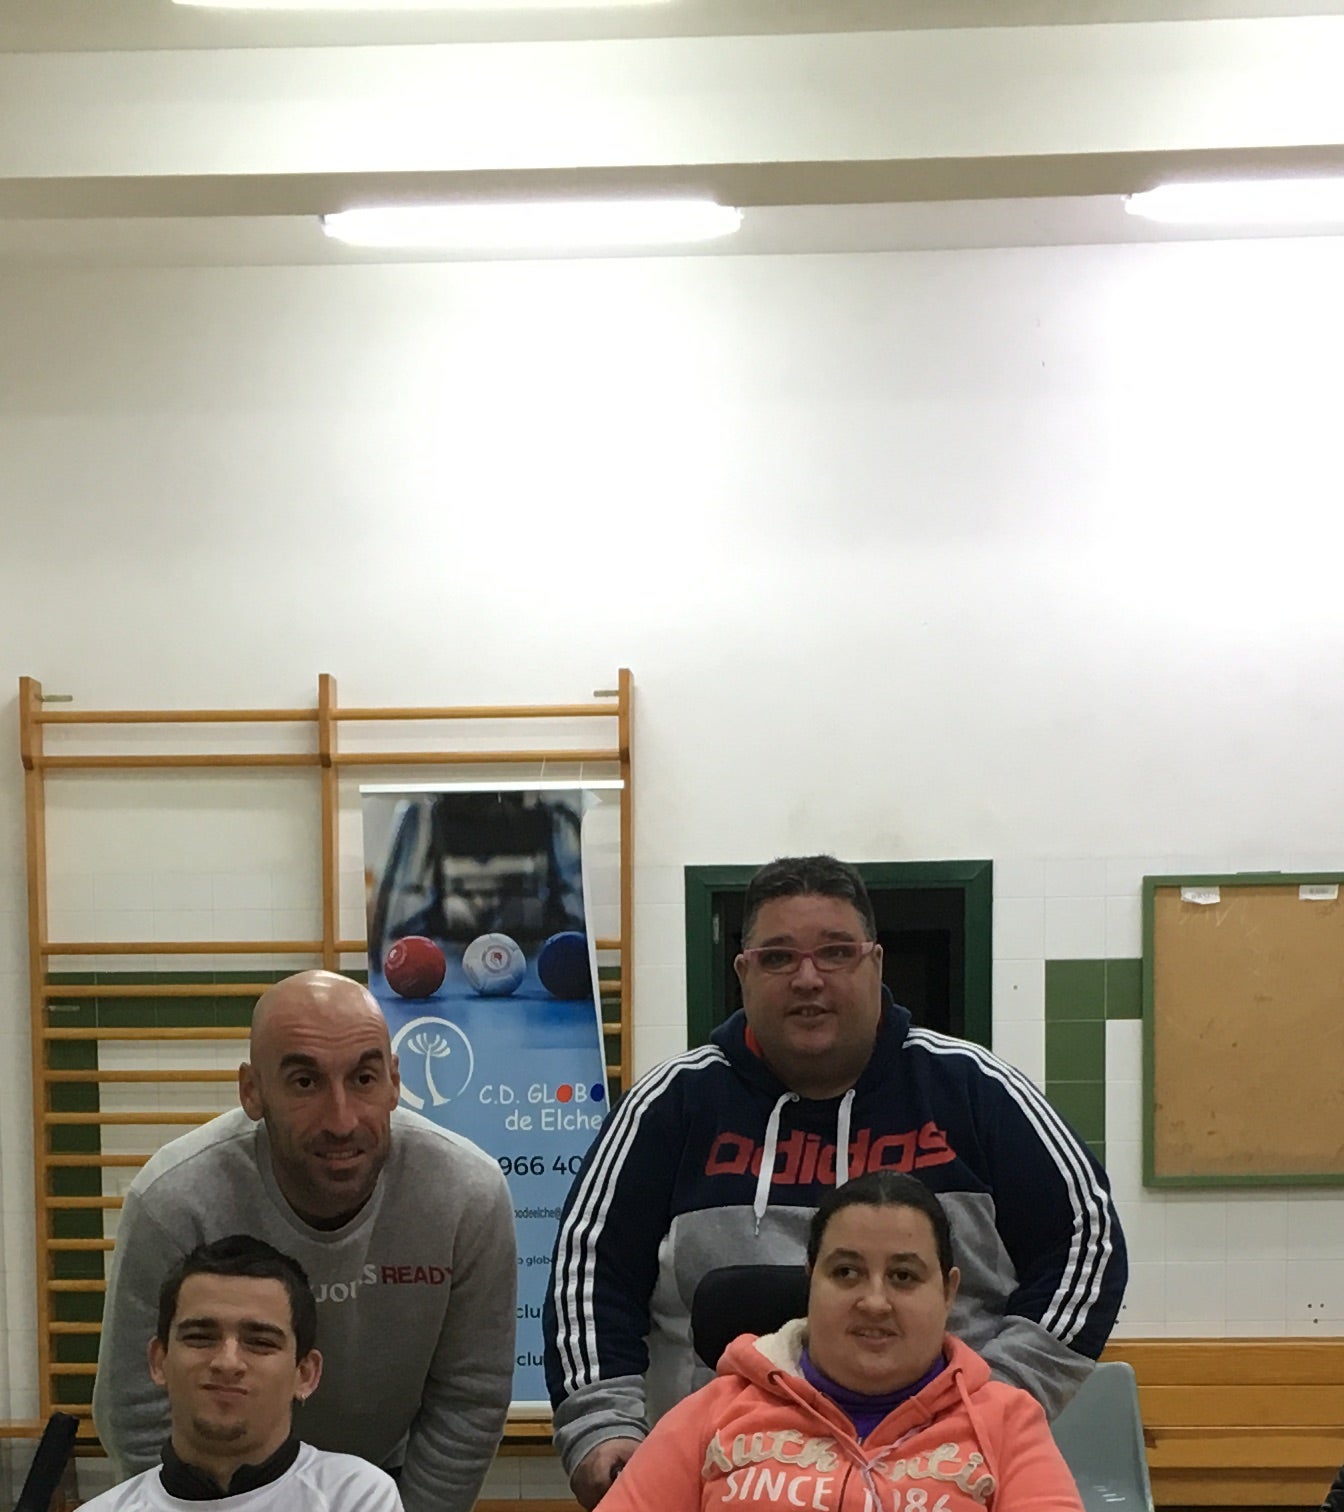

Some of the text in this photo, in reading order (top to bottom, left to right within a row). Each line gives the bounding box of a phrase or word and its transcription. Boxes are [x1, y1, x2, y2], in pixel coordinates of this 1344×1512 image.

[479, 1084, 520, 1105] C.D.
[505, 1108, 603, 1131] de Elche
[498, 1155, 545, 1176] 966
[526, 1256, 553, 1266] glob
[702, 1429, 995, 1506] Authntic
[722, 1467, 834, 1512] SINCE
